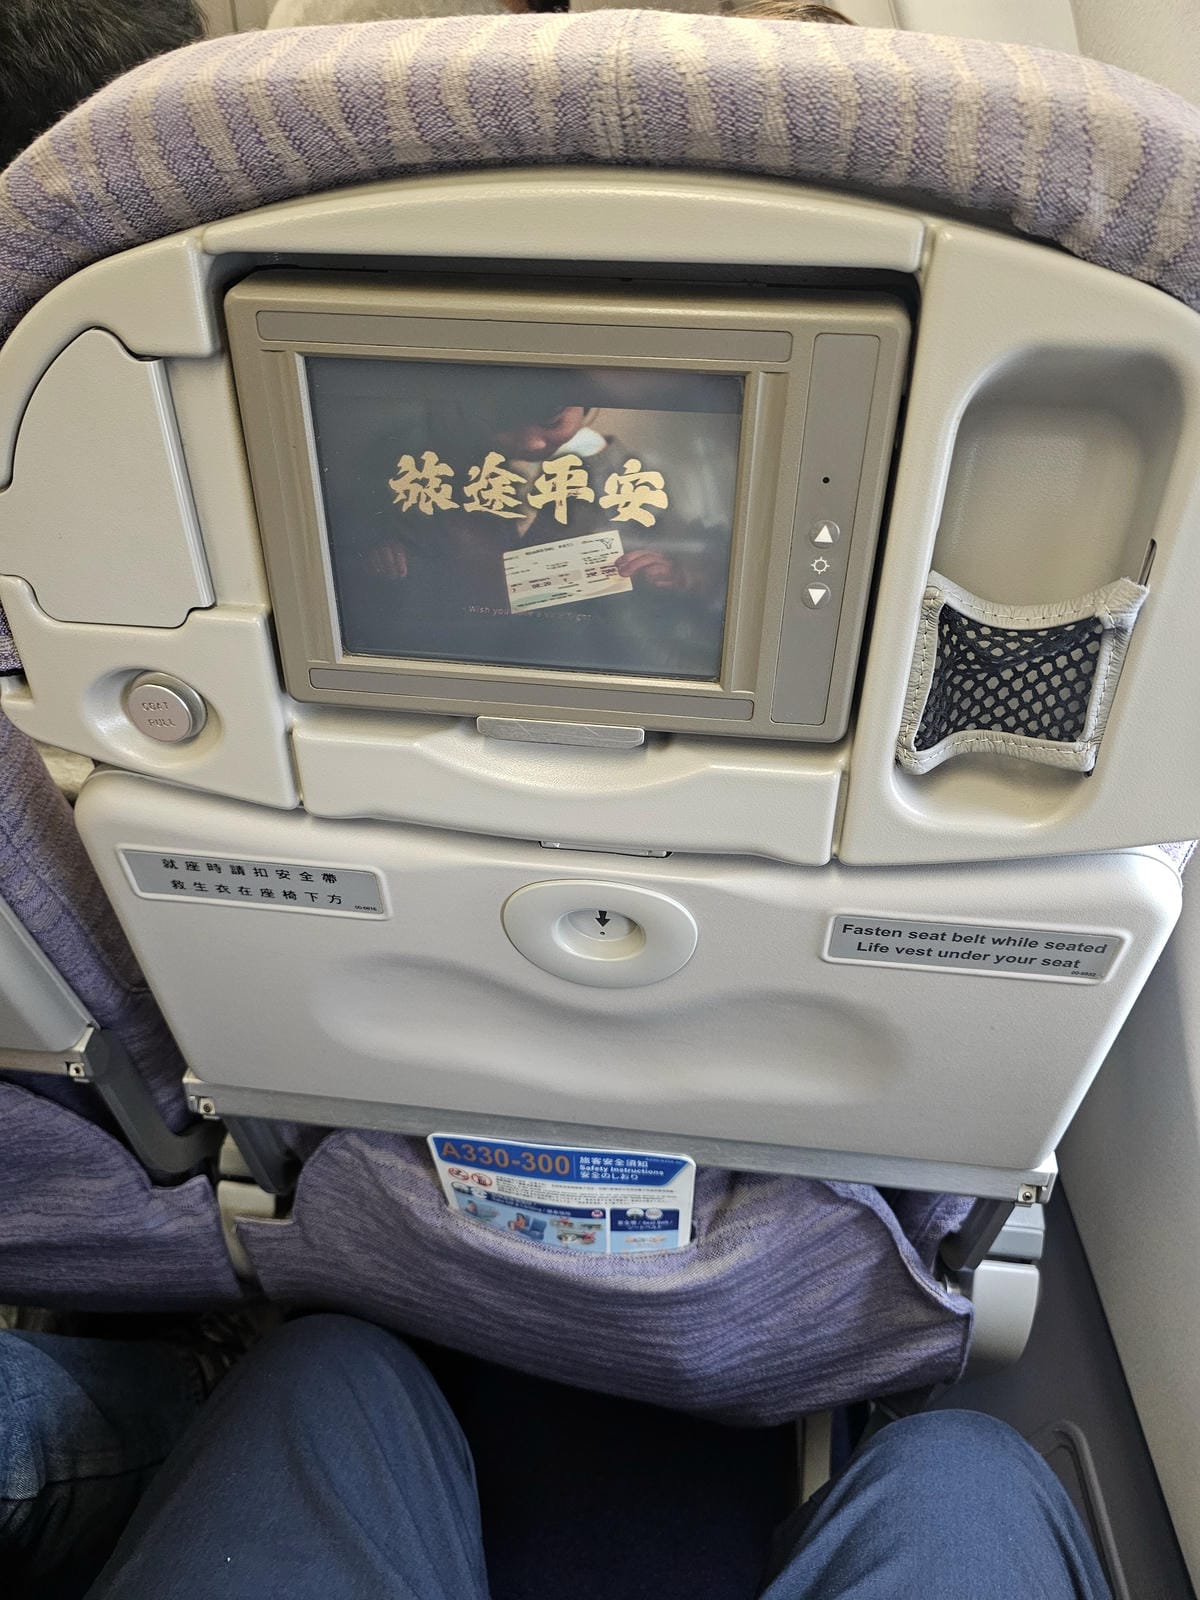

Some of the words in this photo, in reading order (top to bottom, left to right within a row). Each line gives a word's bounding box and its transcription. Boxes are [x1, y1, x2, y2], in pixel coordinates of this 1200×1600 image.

[388, 450, 669, 528] 旅途平安
[147, 718, 177, 728] PULL
[162, 858, 338, 884] 就座時請扣安全帶
[171, 879, 342, 905] 救生衣在座椅下方
[842, 923, 903, 939] Fasten
[907, 928, 947, 942] seat
[952, 932, 987, 945] belt
[991, 936, 1040, 949] while
[1044, 940, 1108, 955] seated
[856, 941, 890, 954] Life
[895, 945, 933, 958] vest
[938, 947, 991, 961] under
[993, 953, 1037, 966] your
[1040, 956, 1082, 969] seat
[441, 1141, 570, 1175] A330-300
[579, 1156, 649, 1168] 旅客安全須知
[580, 1164, 609, 1173] Safety
[610, 1166, 664, 1176] Instructions
[580, 1171, 639, 1180] 安全のしおり
